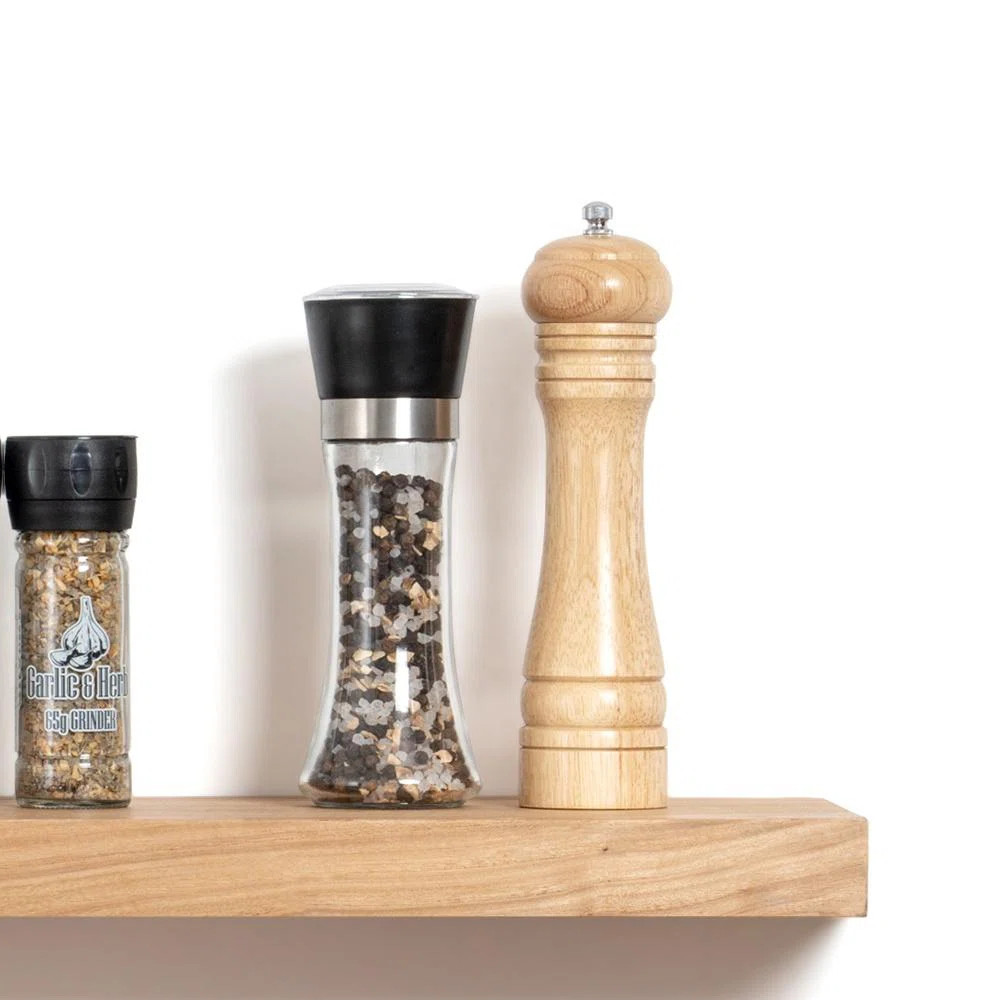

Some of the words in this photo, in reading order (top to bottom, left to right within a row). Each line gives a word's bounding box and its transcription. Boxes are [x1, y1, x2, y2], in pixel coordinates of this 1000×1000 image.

[27, 666, 78, 698] Garlic
[83, 673, 93, 698] &
[46, 710, 67, 733] 65g
[71, 710, 117, 730] GRINDER
